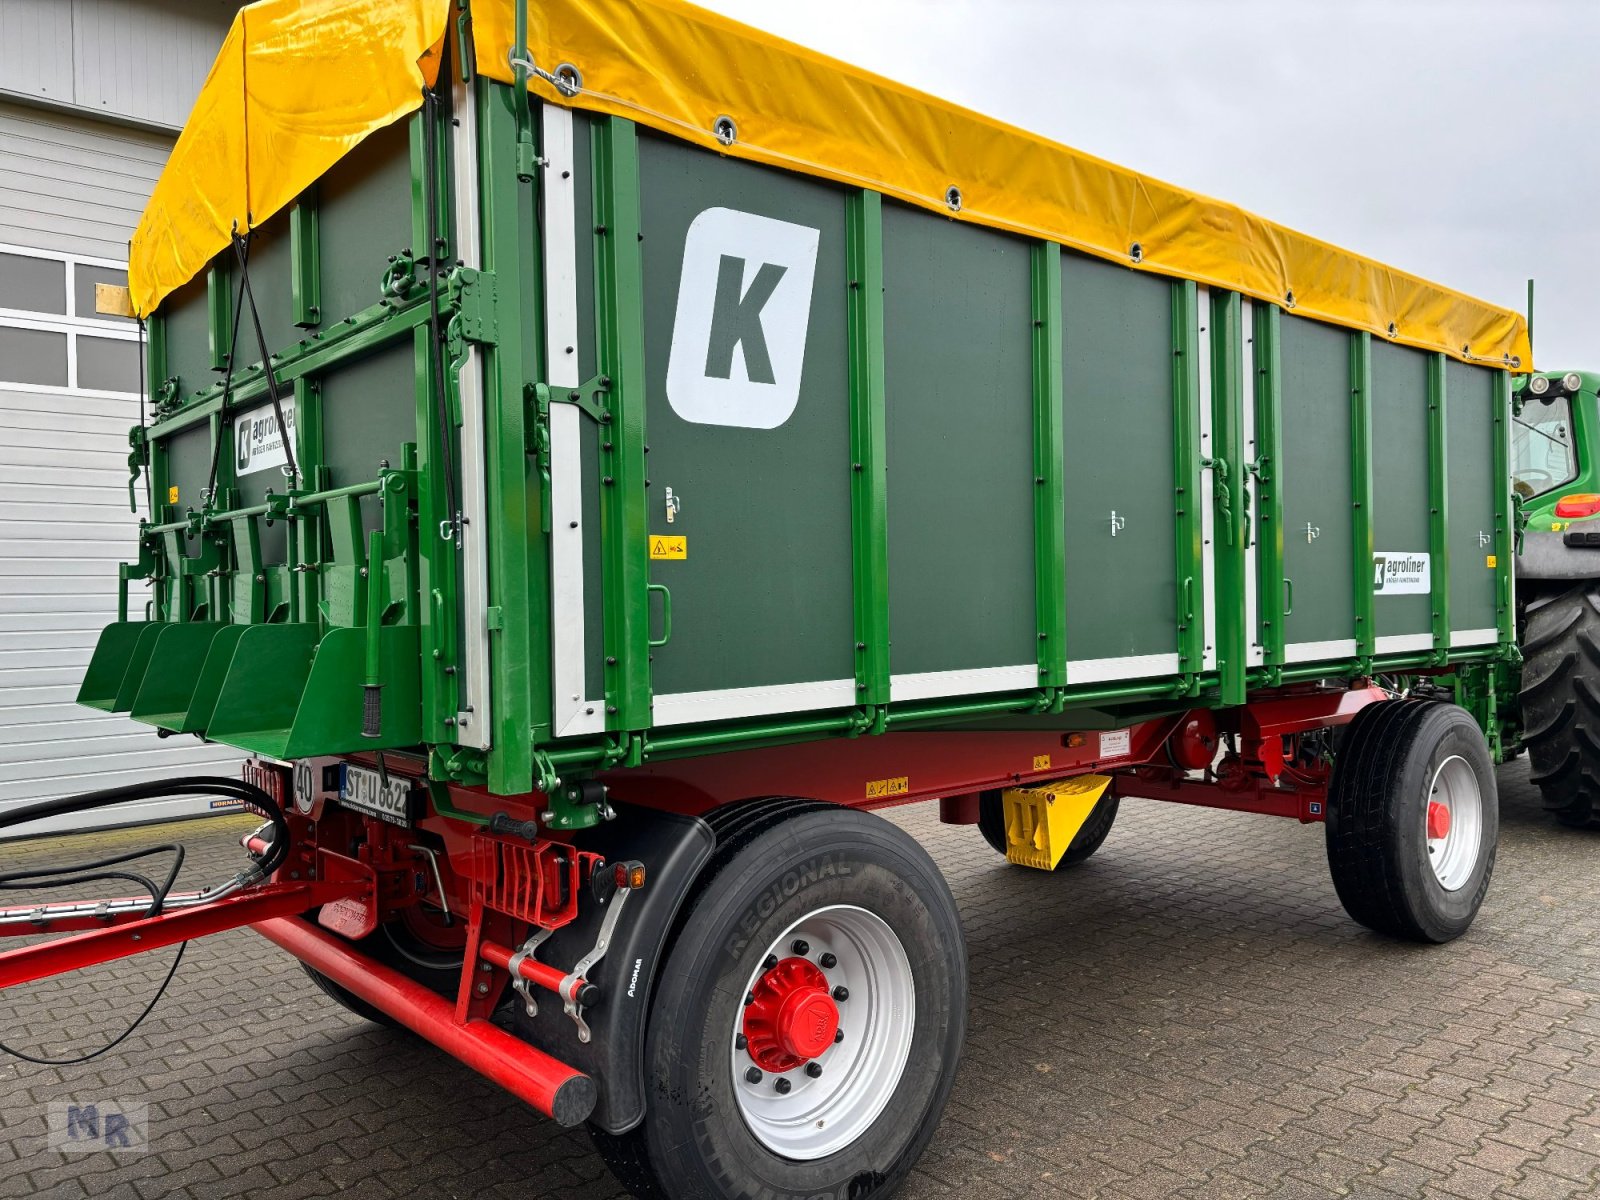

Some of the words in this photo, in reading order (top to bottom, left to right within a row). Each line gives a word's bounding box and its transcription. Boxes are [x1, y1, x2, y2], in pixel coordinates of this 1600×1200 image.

[704, 253, 788, 385] K
[1387, 555, 1425, 577] agroliner
[296, 763, 313, 803] 40
[346, 769, 362, 799] ST
[368, 774, 377, 805] U
[725, 852, 852, 960] REGIONAL
[627, 958, 643, 998] ADOMAR
